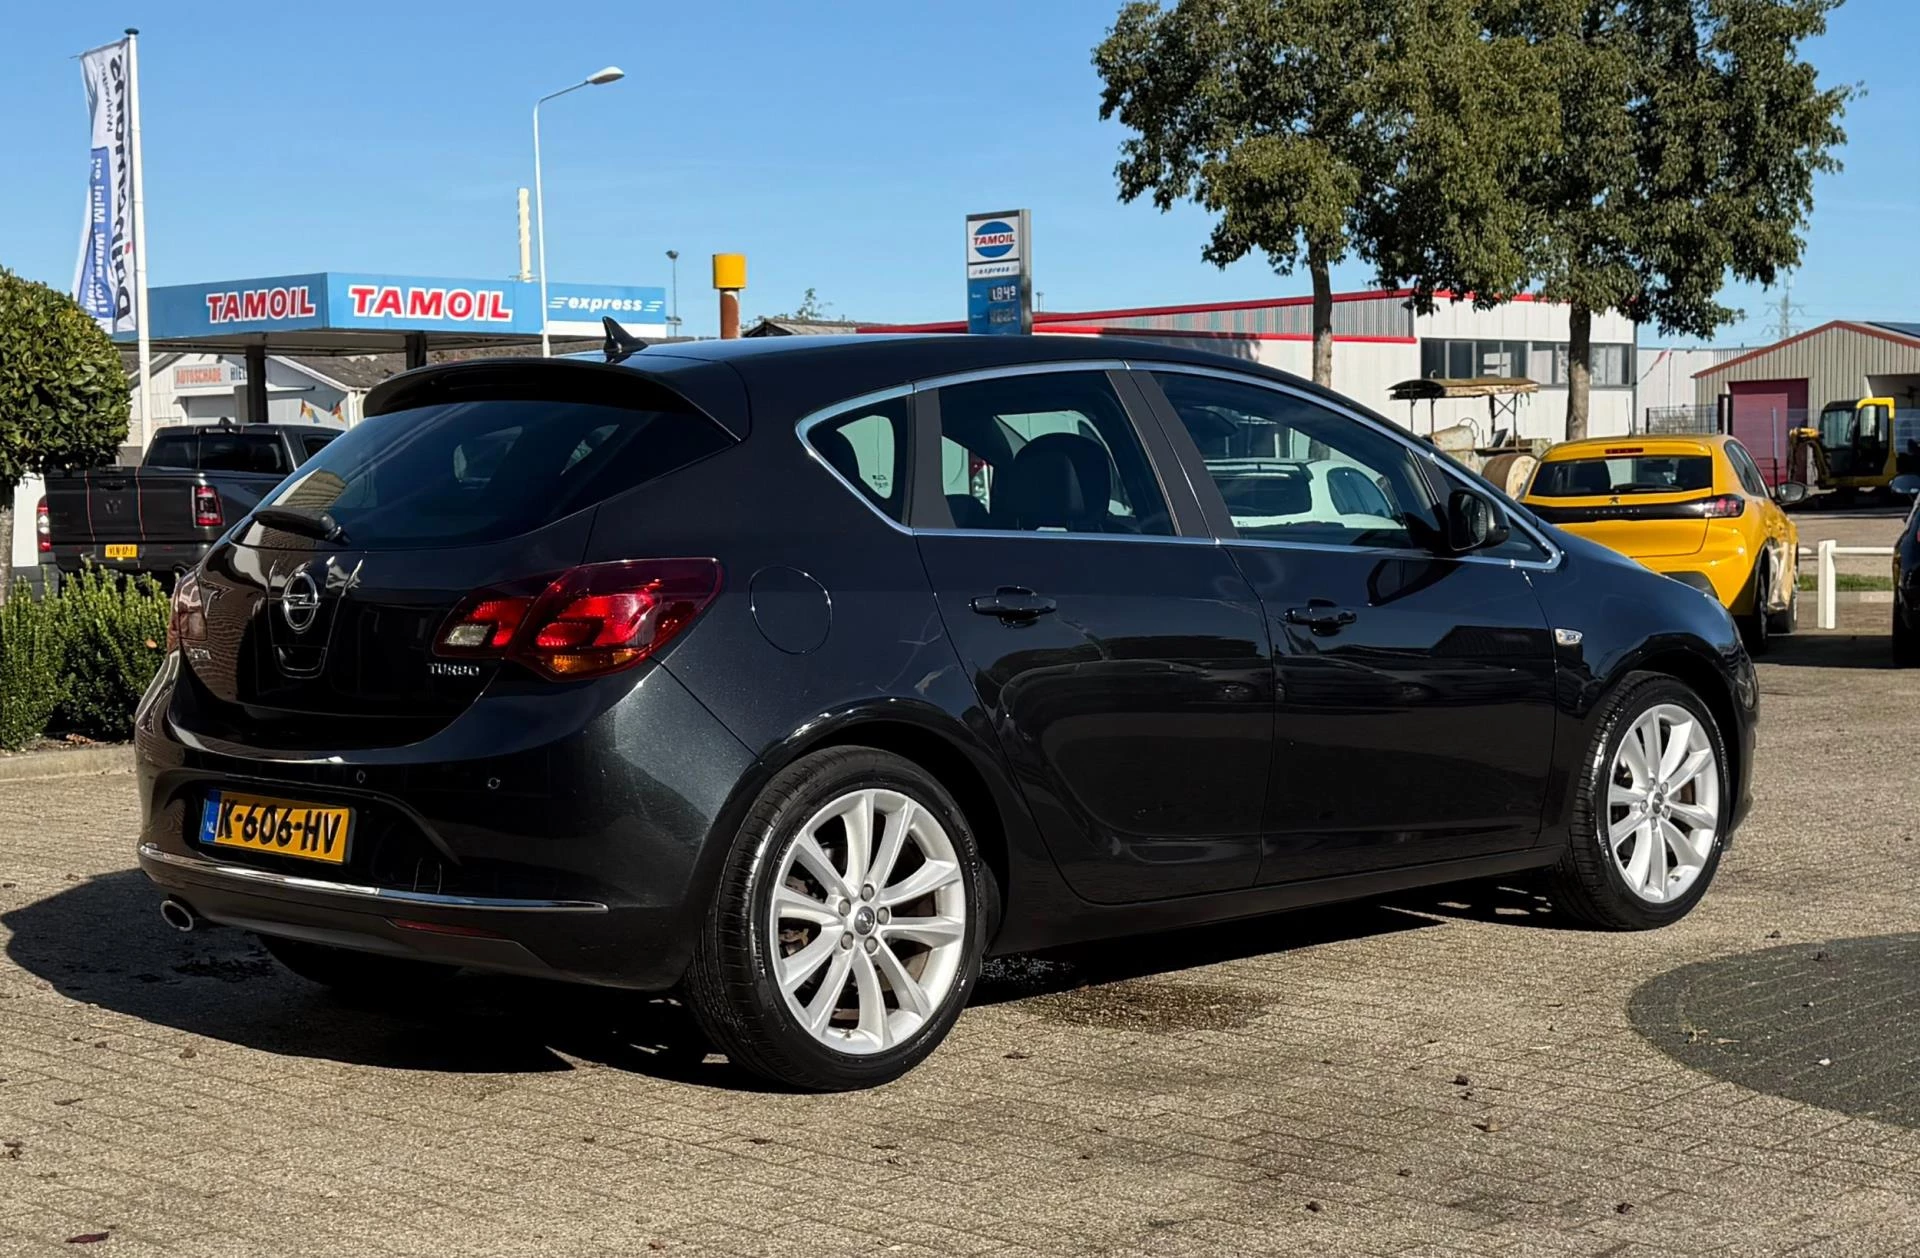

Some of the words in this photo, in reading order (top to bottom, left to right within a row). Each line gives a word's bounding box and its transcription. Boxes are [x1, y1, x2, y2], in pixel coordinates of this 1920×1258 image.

[973, 234, 1015, 246] TAMOIL
[207, 287, 315, 323] TAMOIL
[349, 285, 512, 322] TAMOIL
[568, 297, 643, 313] express
[176, 368, 222, 384] AUTOSCHADE
[427, 662, 480, 676] TURBO
[217, 798, 342, 854] K-606-HV
